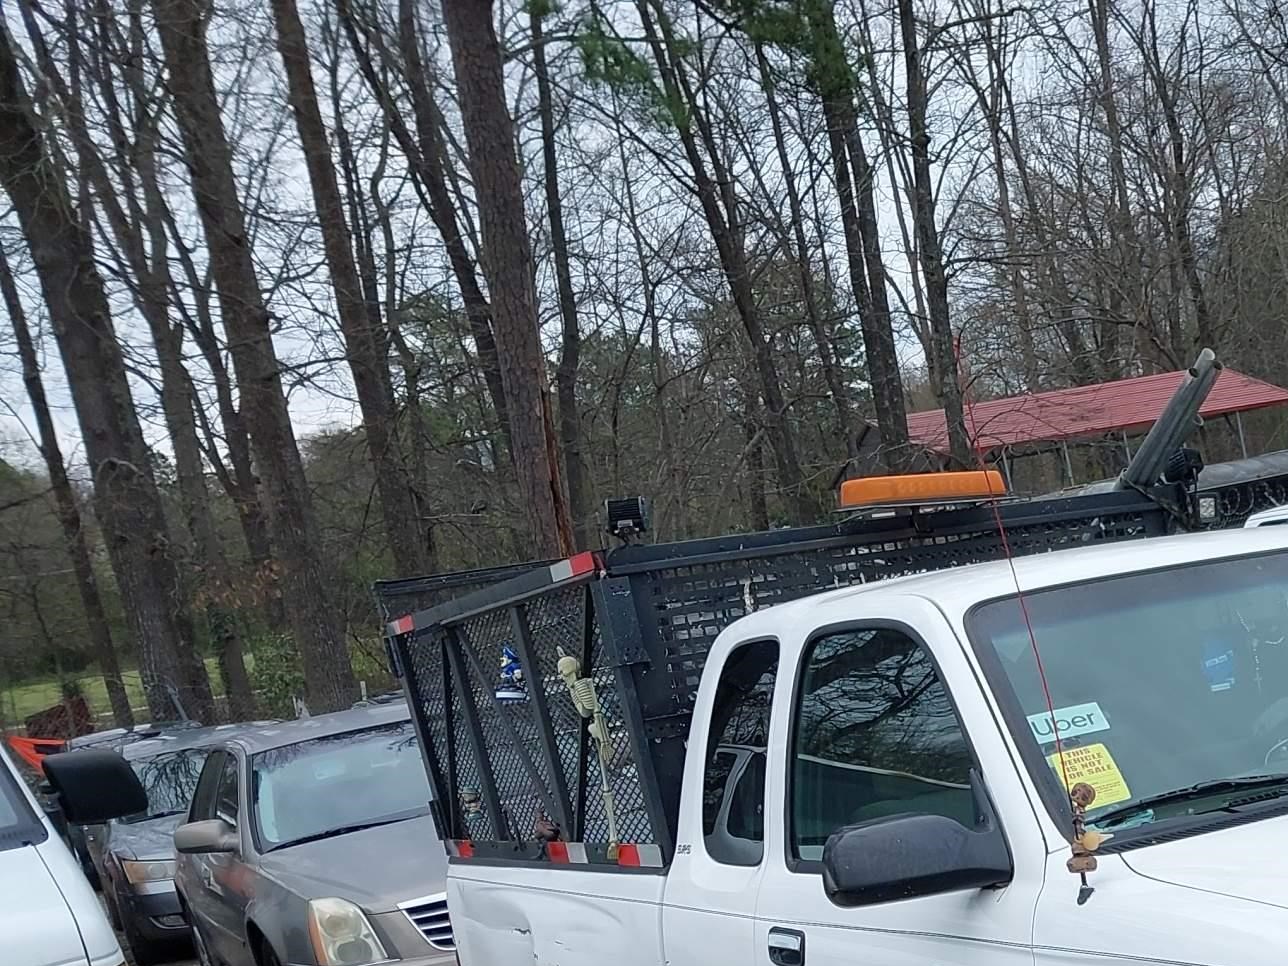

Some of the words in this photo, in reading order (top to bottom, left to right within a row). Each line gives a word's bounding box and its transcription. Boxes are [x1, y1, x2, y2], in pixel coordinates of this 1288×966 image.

[1031, 711, 1095, 736] Uber
[1065, 748, 1091, 759] THIS
[1066, 765, 1079, 773] IS
[1081, 759, 1103, 771] NOT
[1088, 764, 1114, 776] SALE
